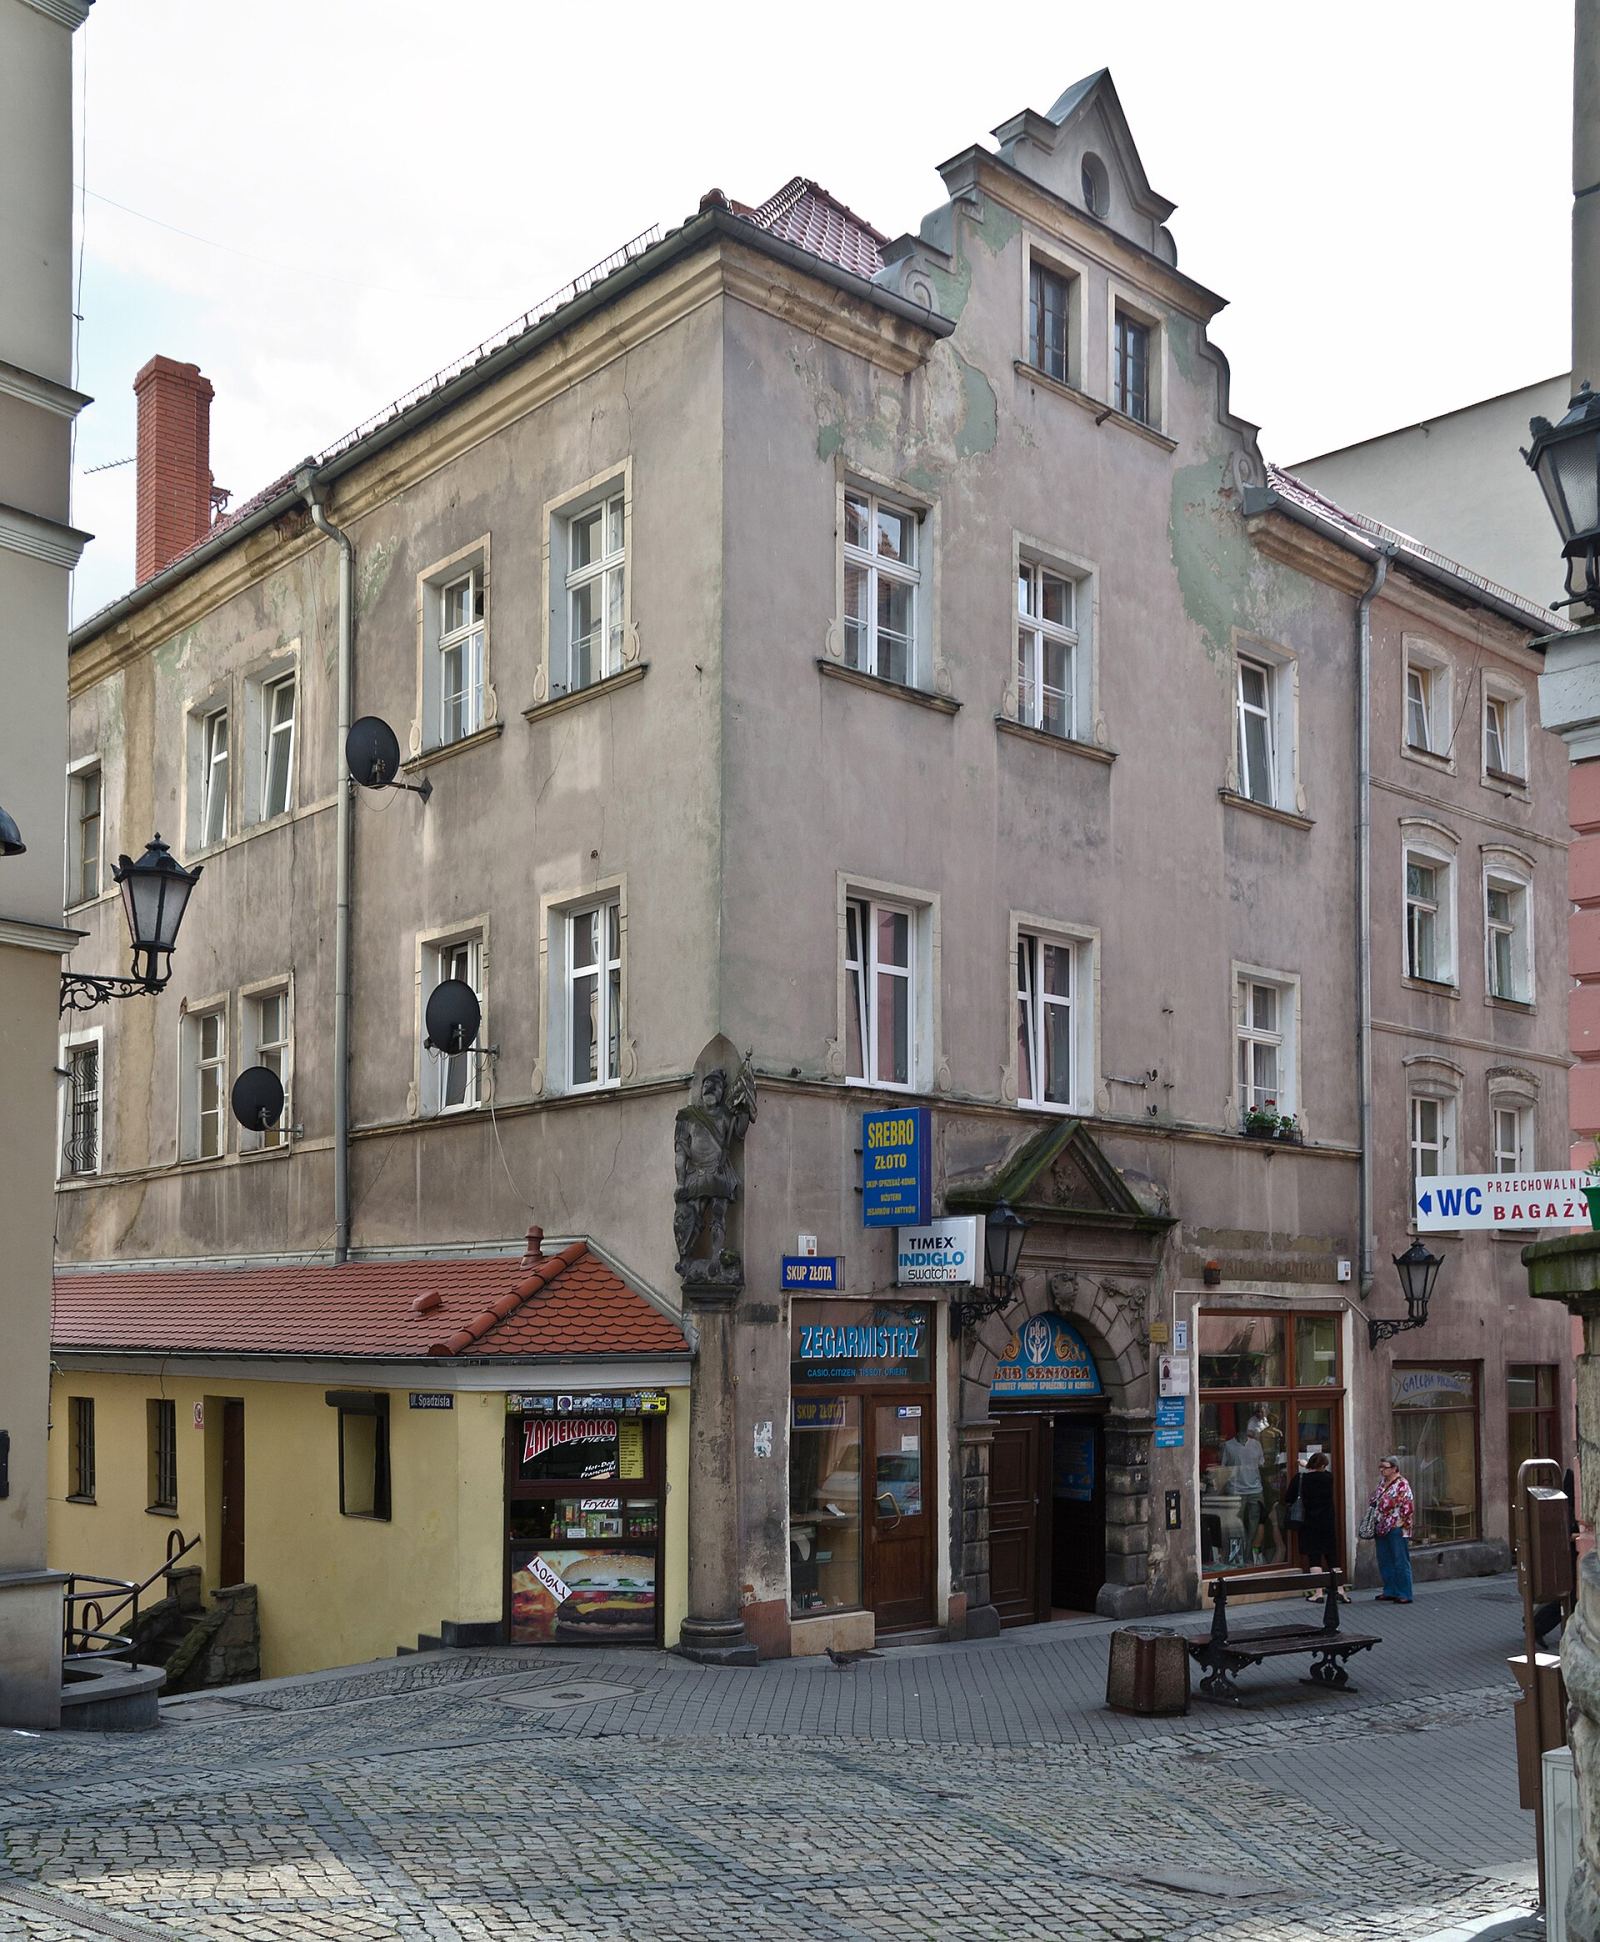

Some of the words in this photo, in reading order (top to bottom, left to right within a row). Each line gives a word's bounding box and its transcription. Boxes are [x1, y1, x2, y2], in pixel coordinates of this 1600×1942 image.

[867, 1119, 914, 1149] SREBRO
[874, 1154, 907, 1170] ZŁOTO
[1437, 1187, 1483, 1216] WC
[1487, 1177, 1591, 1193] PRZECHOWALNIA
[1493, 1198, 1588, 1220] BAGAŻY
[909, 1236, 954, 1250] TIMEX
[899, 1251, 965, 1267] INDIGLO
[786, 1265, 808, 1280] SKUP
[809, 1265, 832, 1281] ZŁOTA
[907, 1267, 949, 1280] swatch
[800, 1325, 919, 1358] ZEGARMISTRZ
[1178, 1333, 1182, 1344] 1
[1026, 1365, 1090, 1380] SENIORA
[418, 1394, 451, 1408] Spadzista
[797, 1404, 817, 1419] SKUP
[523, 1419, 617, 1463] ZAPIEKANKA
[583, 1498, 617, 1510] Frytki
[531, 1558, 568, 1600] TOSTY
